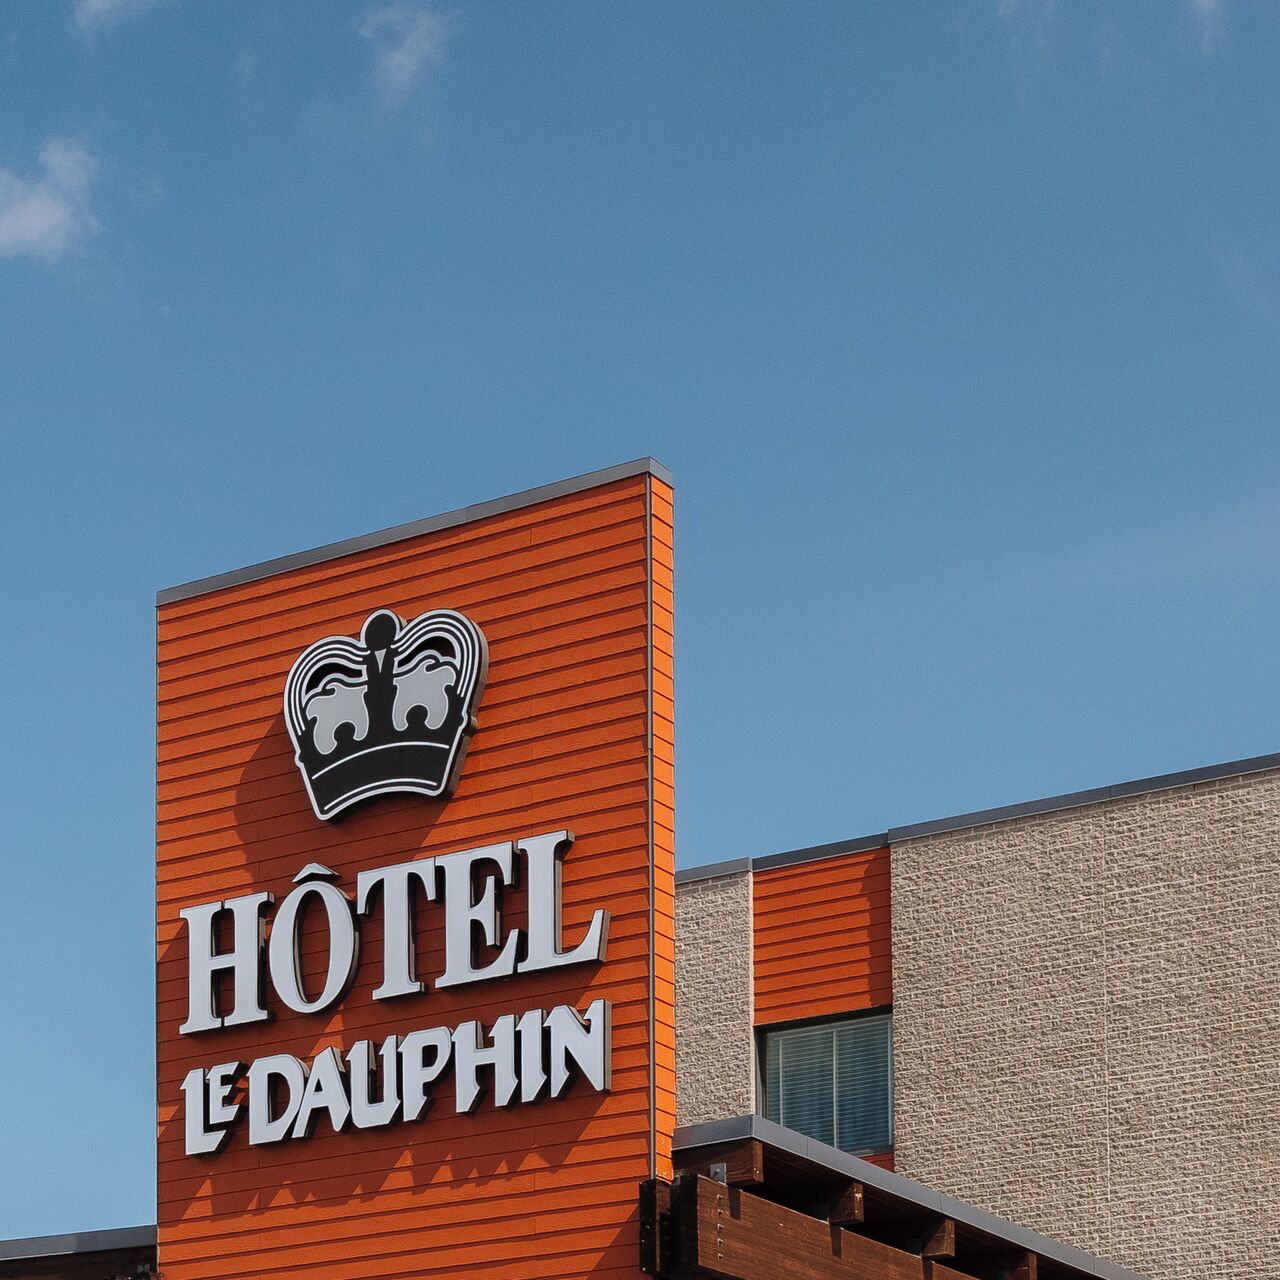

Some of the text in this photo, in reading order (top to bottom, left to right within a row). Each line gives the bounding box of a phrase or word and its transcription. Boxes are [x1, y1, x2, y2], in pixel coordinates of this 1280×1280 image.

[179, 830, 609, 1036] HÔTEL
[180, 999, 611, 1156] LE DAUPHIN
